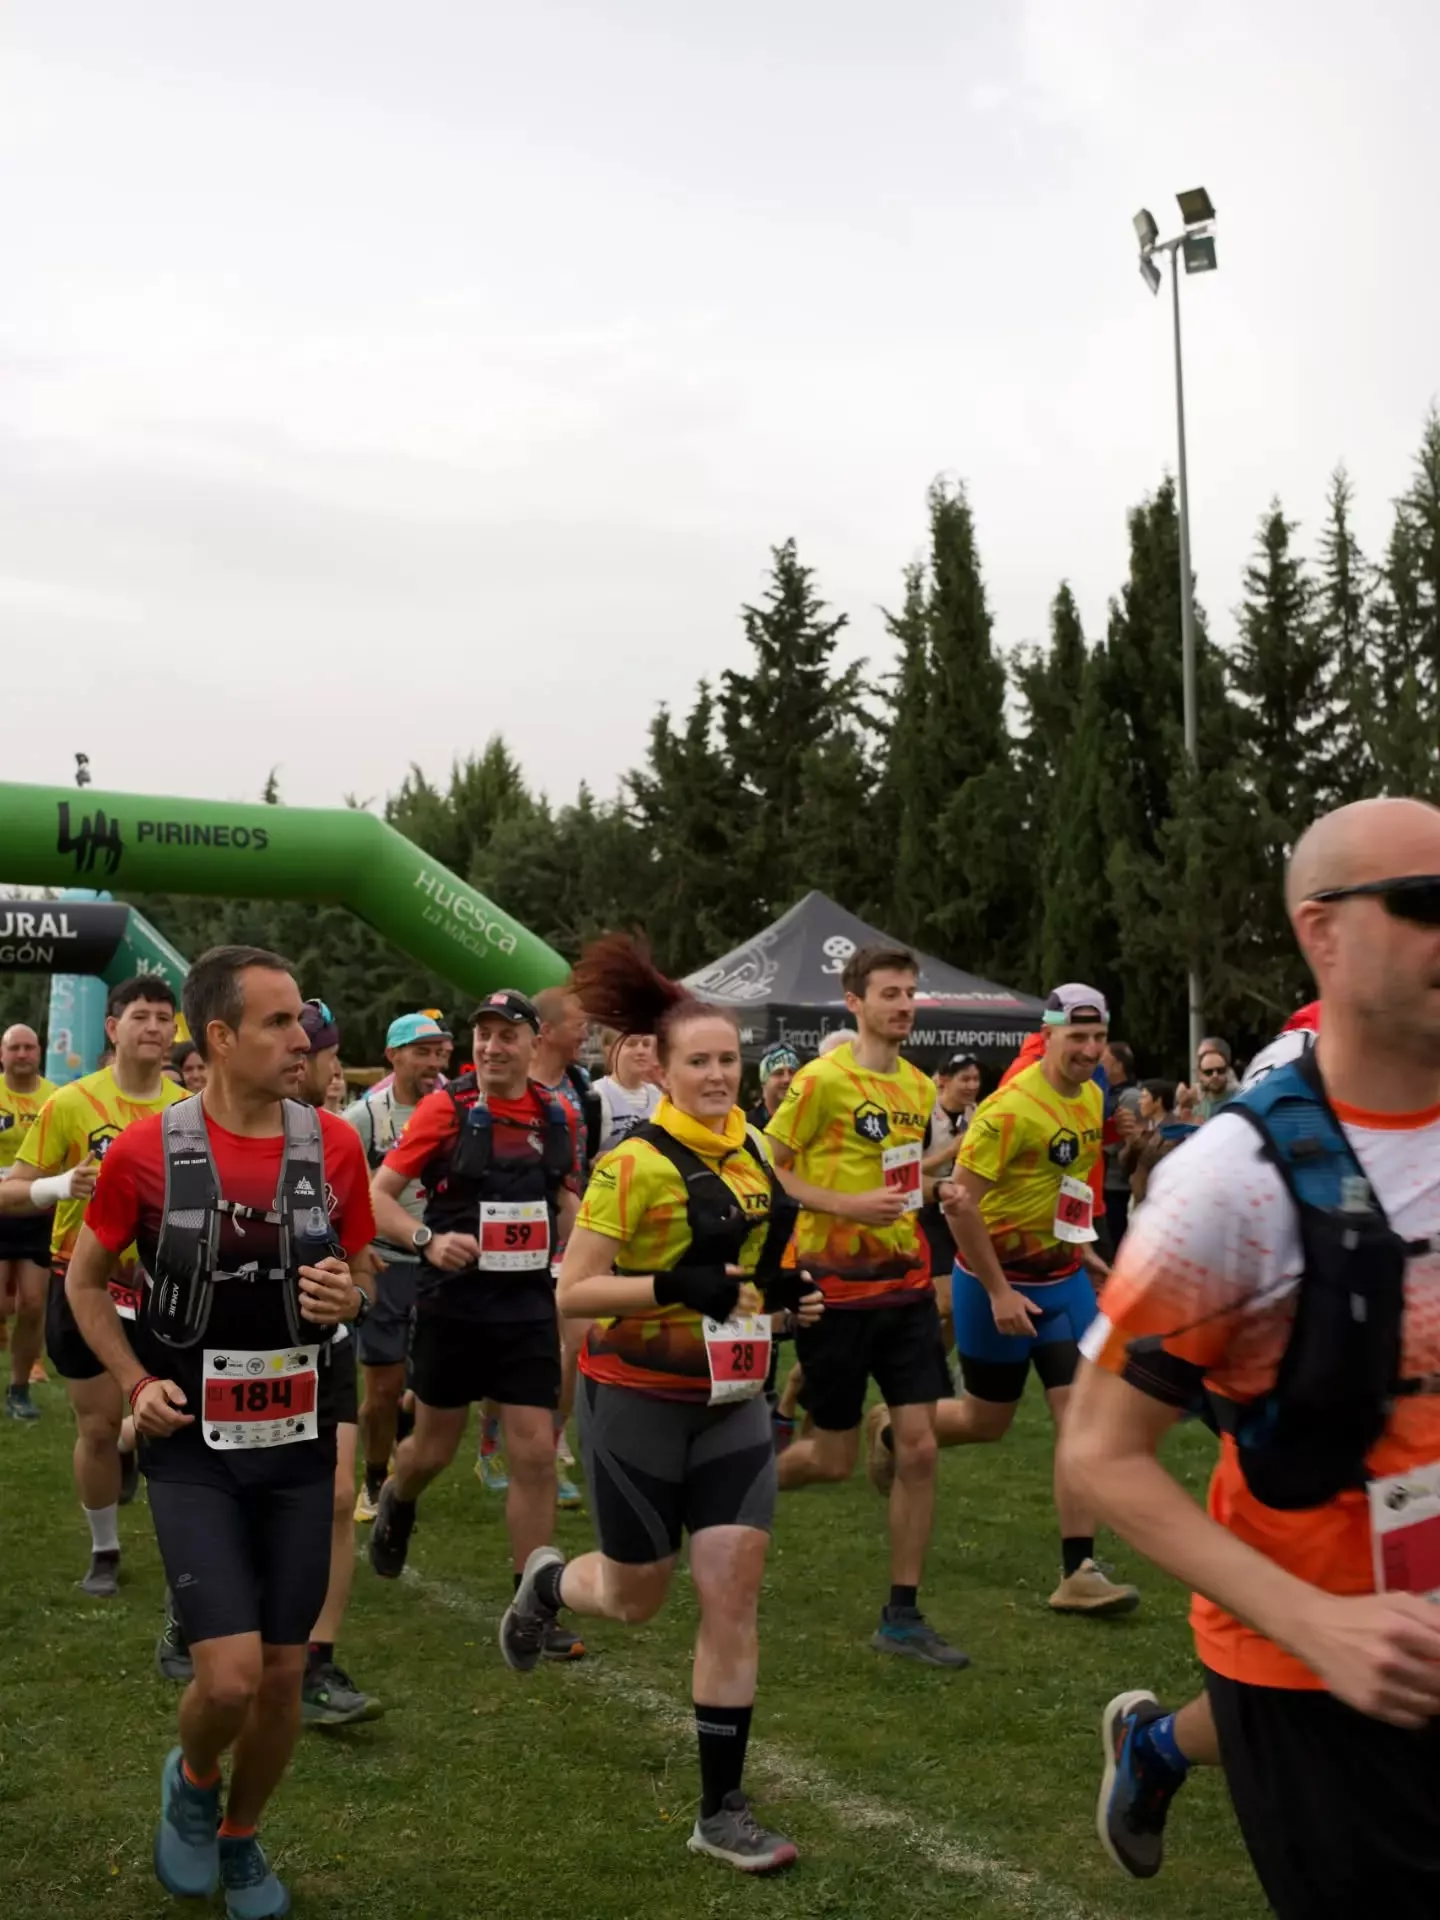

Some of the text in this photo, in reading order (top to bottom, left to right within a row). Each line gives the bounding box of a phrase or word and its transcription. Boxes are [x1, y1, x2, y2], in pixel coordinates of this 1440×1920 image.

[137, 821, 269, 850] PIRINEOS
[903, 1029, 1031, 1047] WW.TEMPOFINIT
[504, 1224, 531, 1246] 59
[732, 1343, 754, 1371] 28
[231, 1379, 292, 1412] 184
